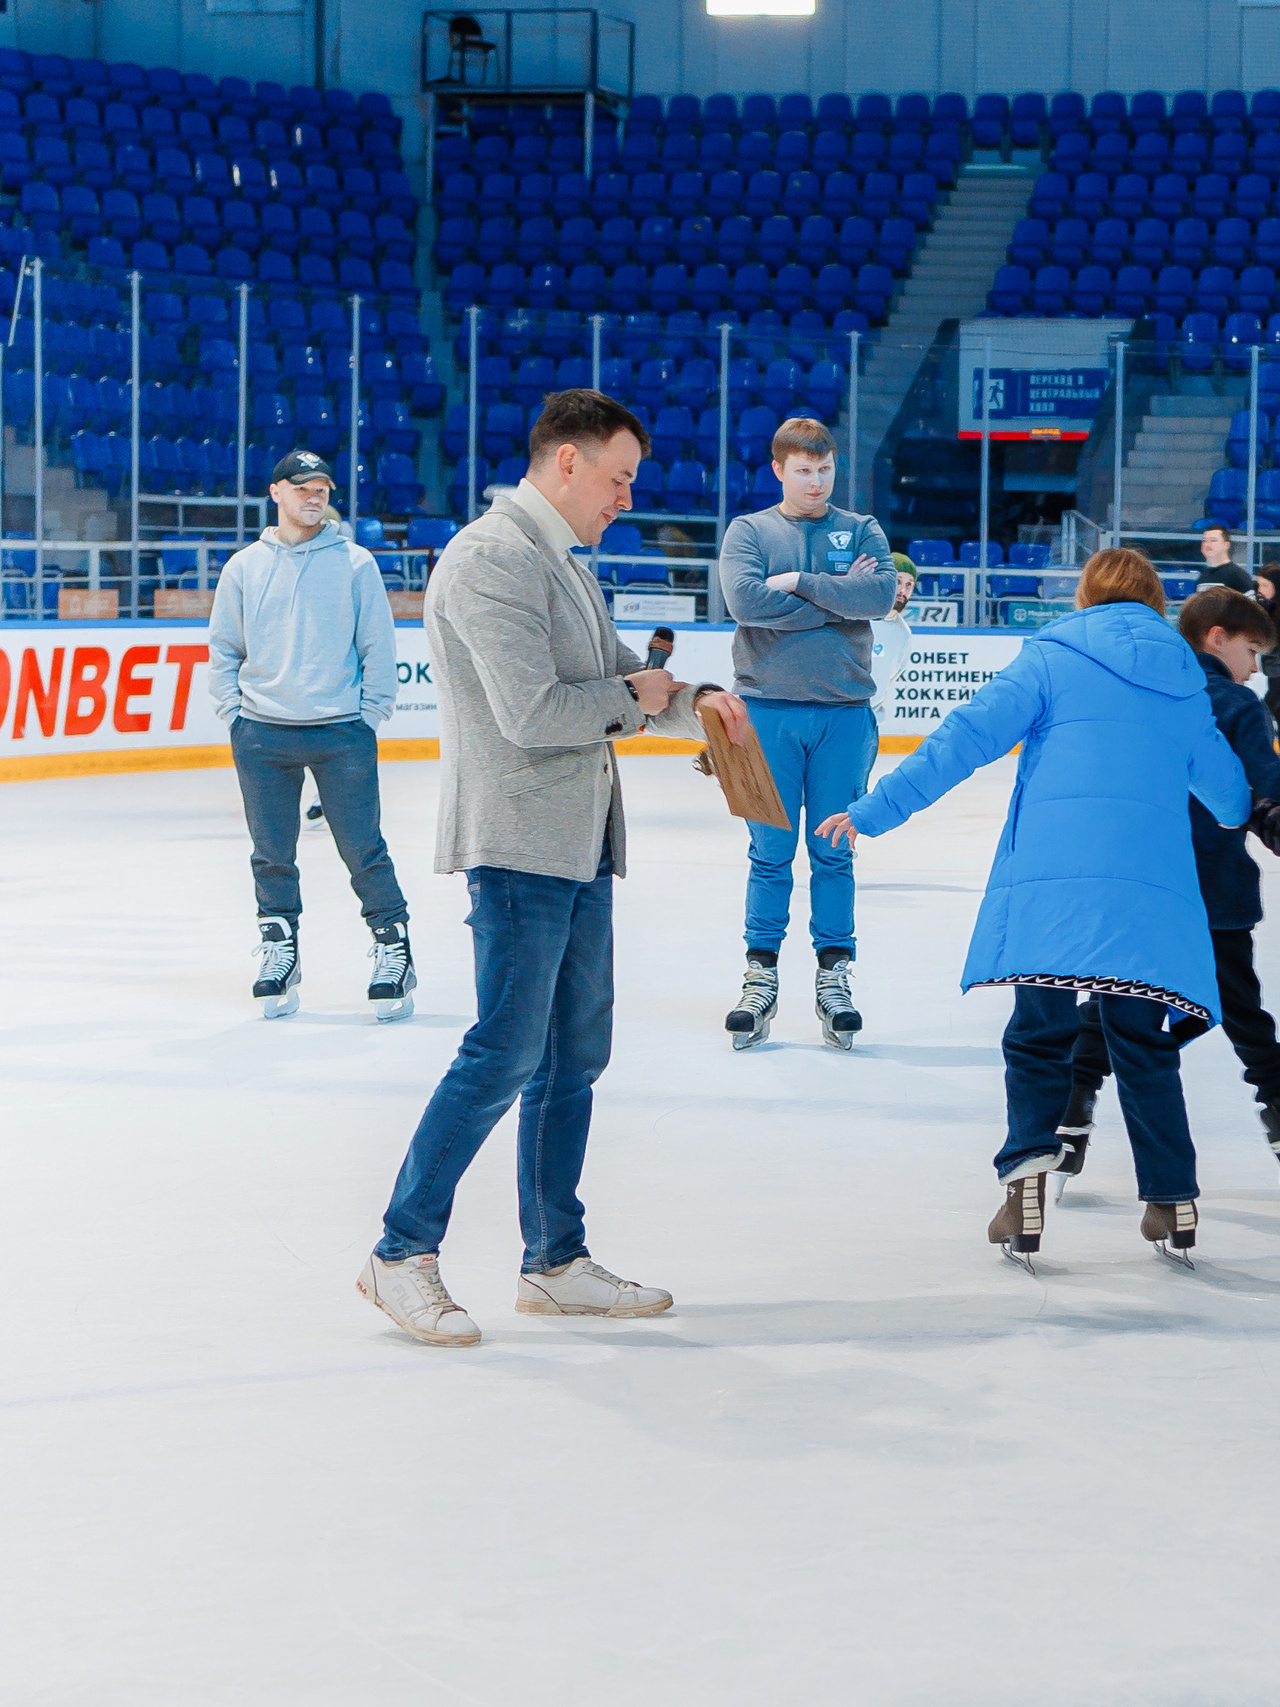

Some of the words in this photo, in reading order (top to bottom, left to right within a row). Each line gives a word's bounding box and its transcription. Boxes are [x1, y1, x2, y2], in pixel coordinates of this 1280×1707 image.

[1029, 374, 1073, 386] ПЕРЕХОД
[1029, 387, 1100, 399] ЦЕНТРАЛЬНЫЙ
[909, 651, 970, 665] ОНБЕТ
[895, 669, 1001, 683] КОНТИНЕН
[0, 644, 210, 740] NBET
[894, 706, 941, 719] ЛИГА
